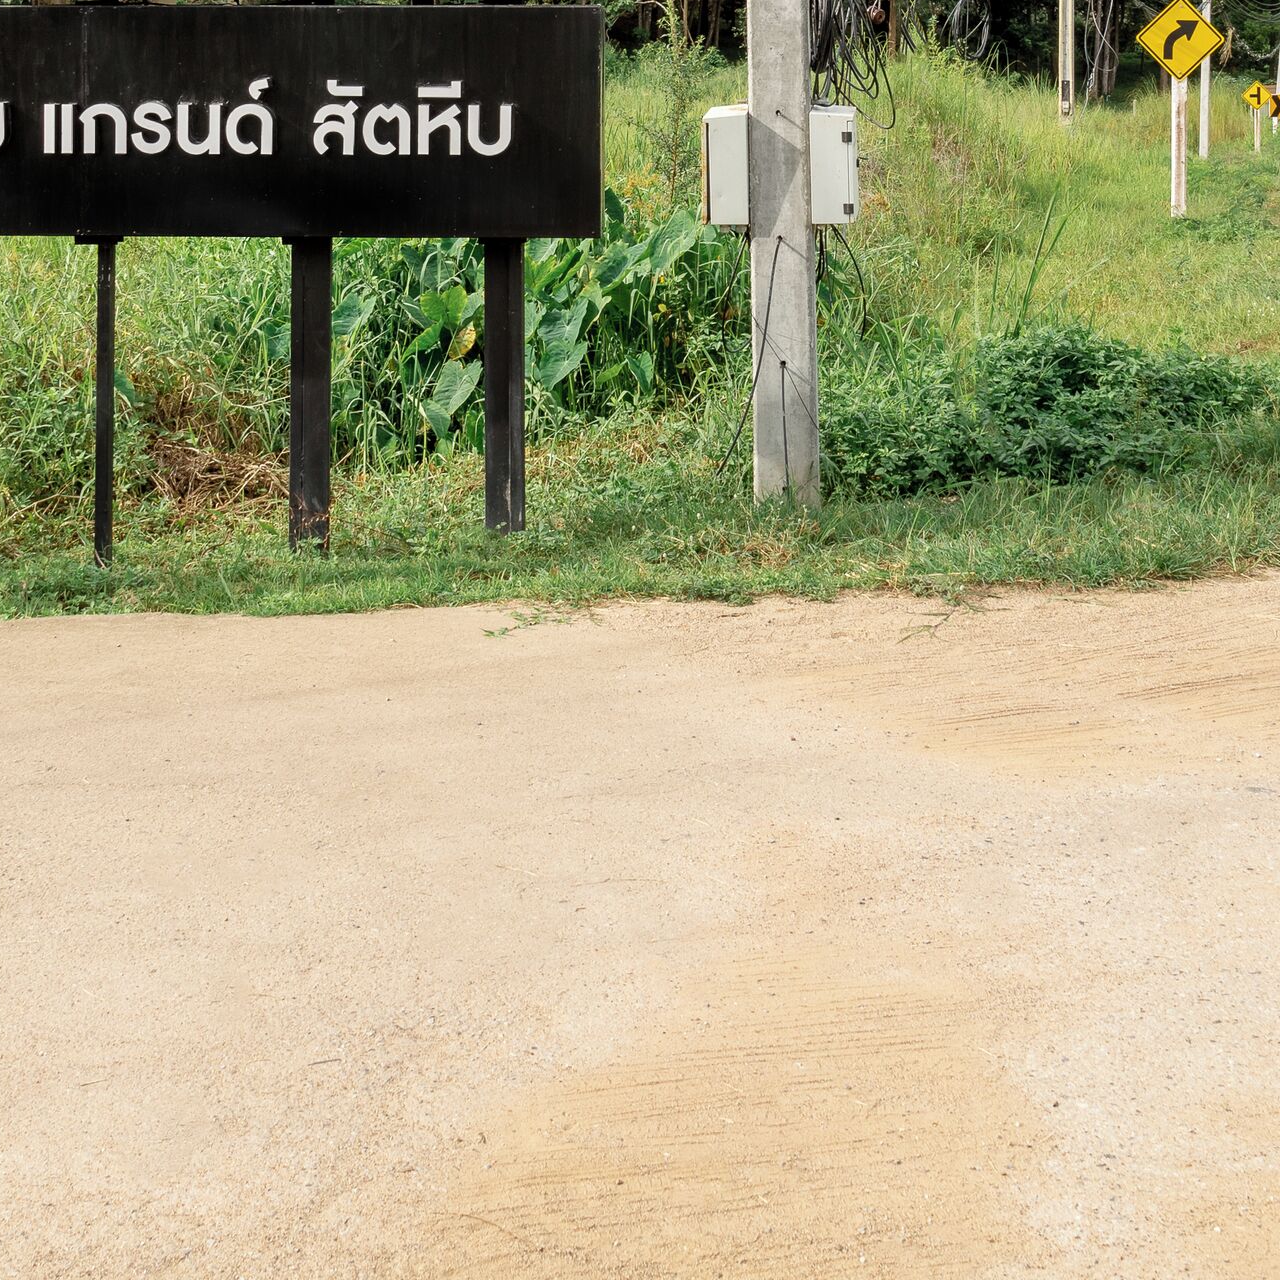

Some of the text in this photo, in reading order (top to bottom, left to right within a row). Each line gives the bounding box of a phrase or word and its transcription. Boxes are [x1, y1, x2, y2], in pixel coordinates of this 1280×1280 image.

[43, 76, 274, 156] แกรนด์
[312, 79, 514, 157] สัตหีบ
